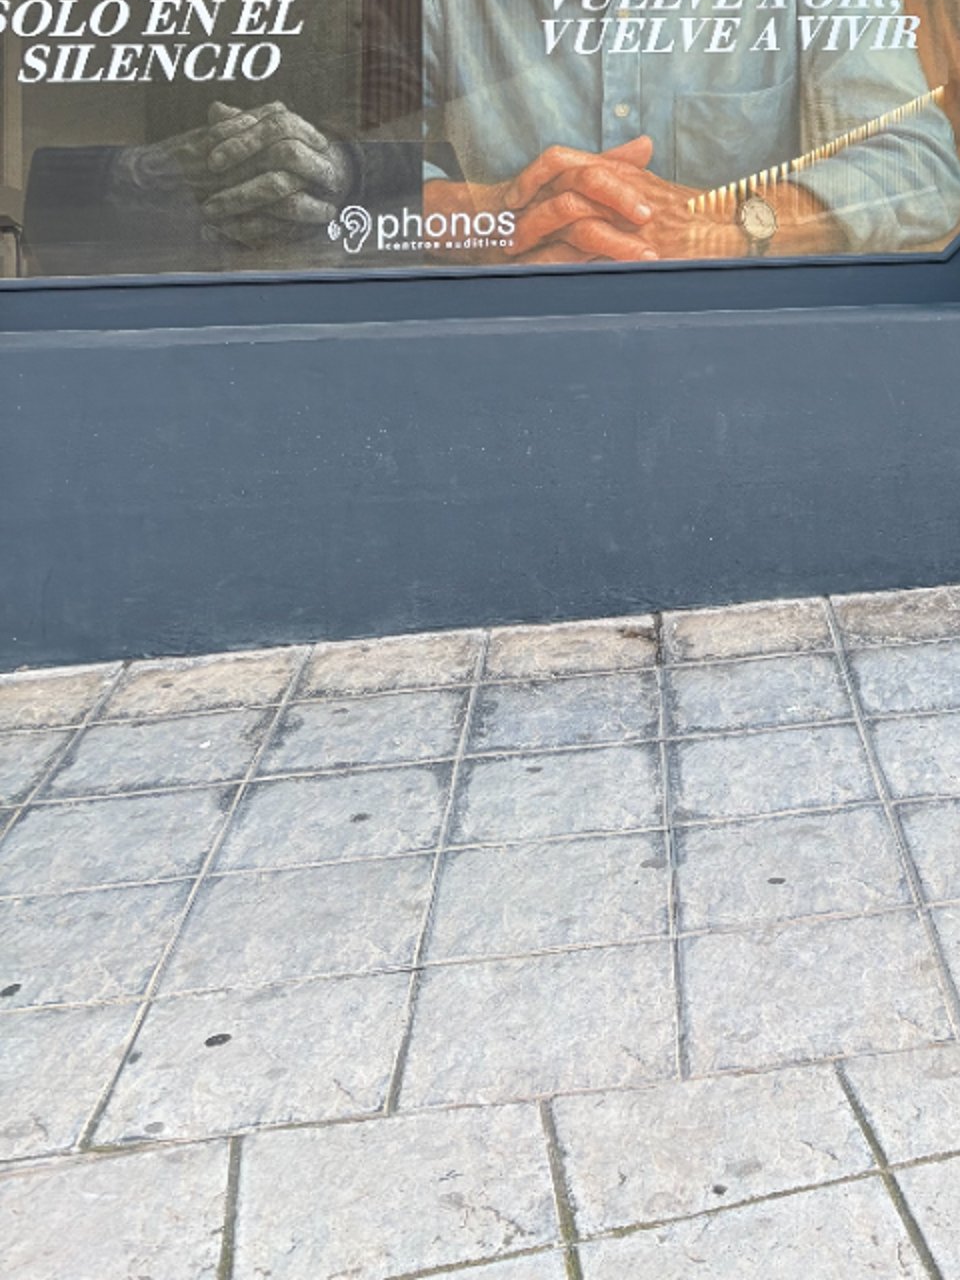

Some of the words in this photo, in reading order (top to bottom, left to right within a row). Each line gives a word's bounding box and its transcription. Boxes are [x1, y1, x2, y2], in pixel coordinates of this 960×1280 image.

[541, 16, 741, 55] VUELVE
[750, 16, 781, 52] A
[797, 14, 921, 51] VIVIR
[17, 42, 282, 84] SILENCIO
[377, 206, 516, 251] phonos
[384, 241, 440, 251] centros
[445, 237, 515, 249] auditivos
